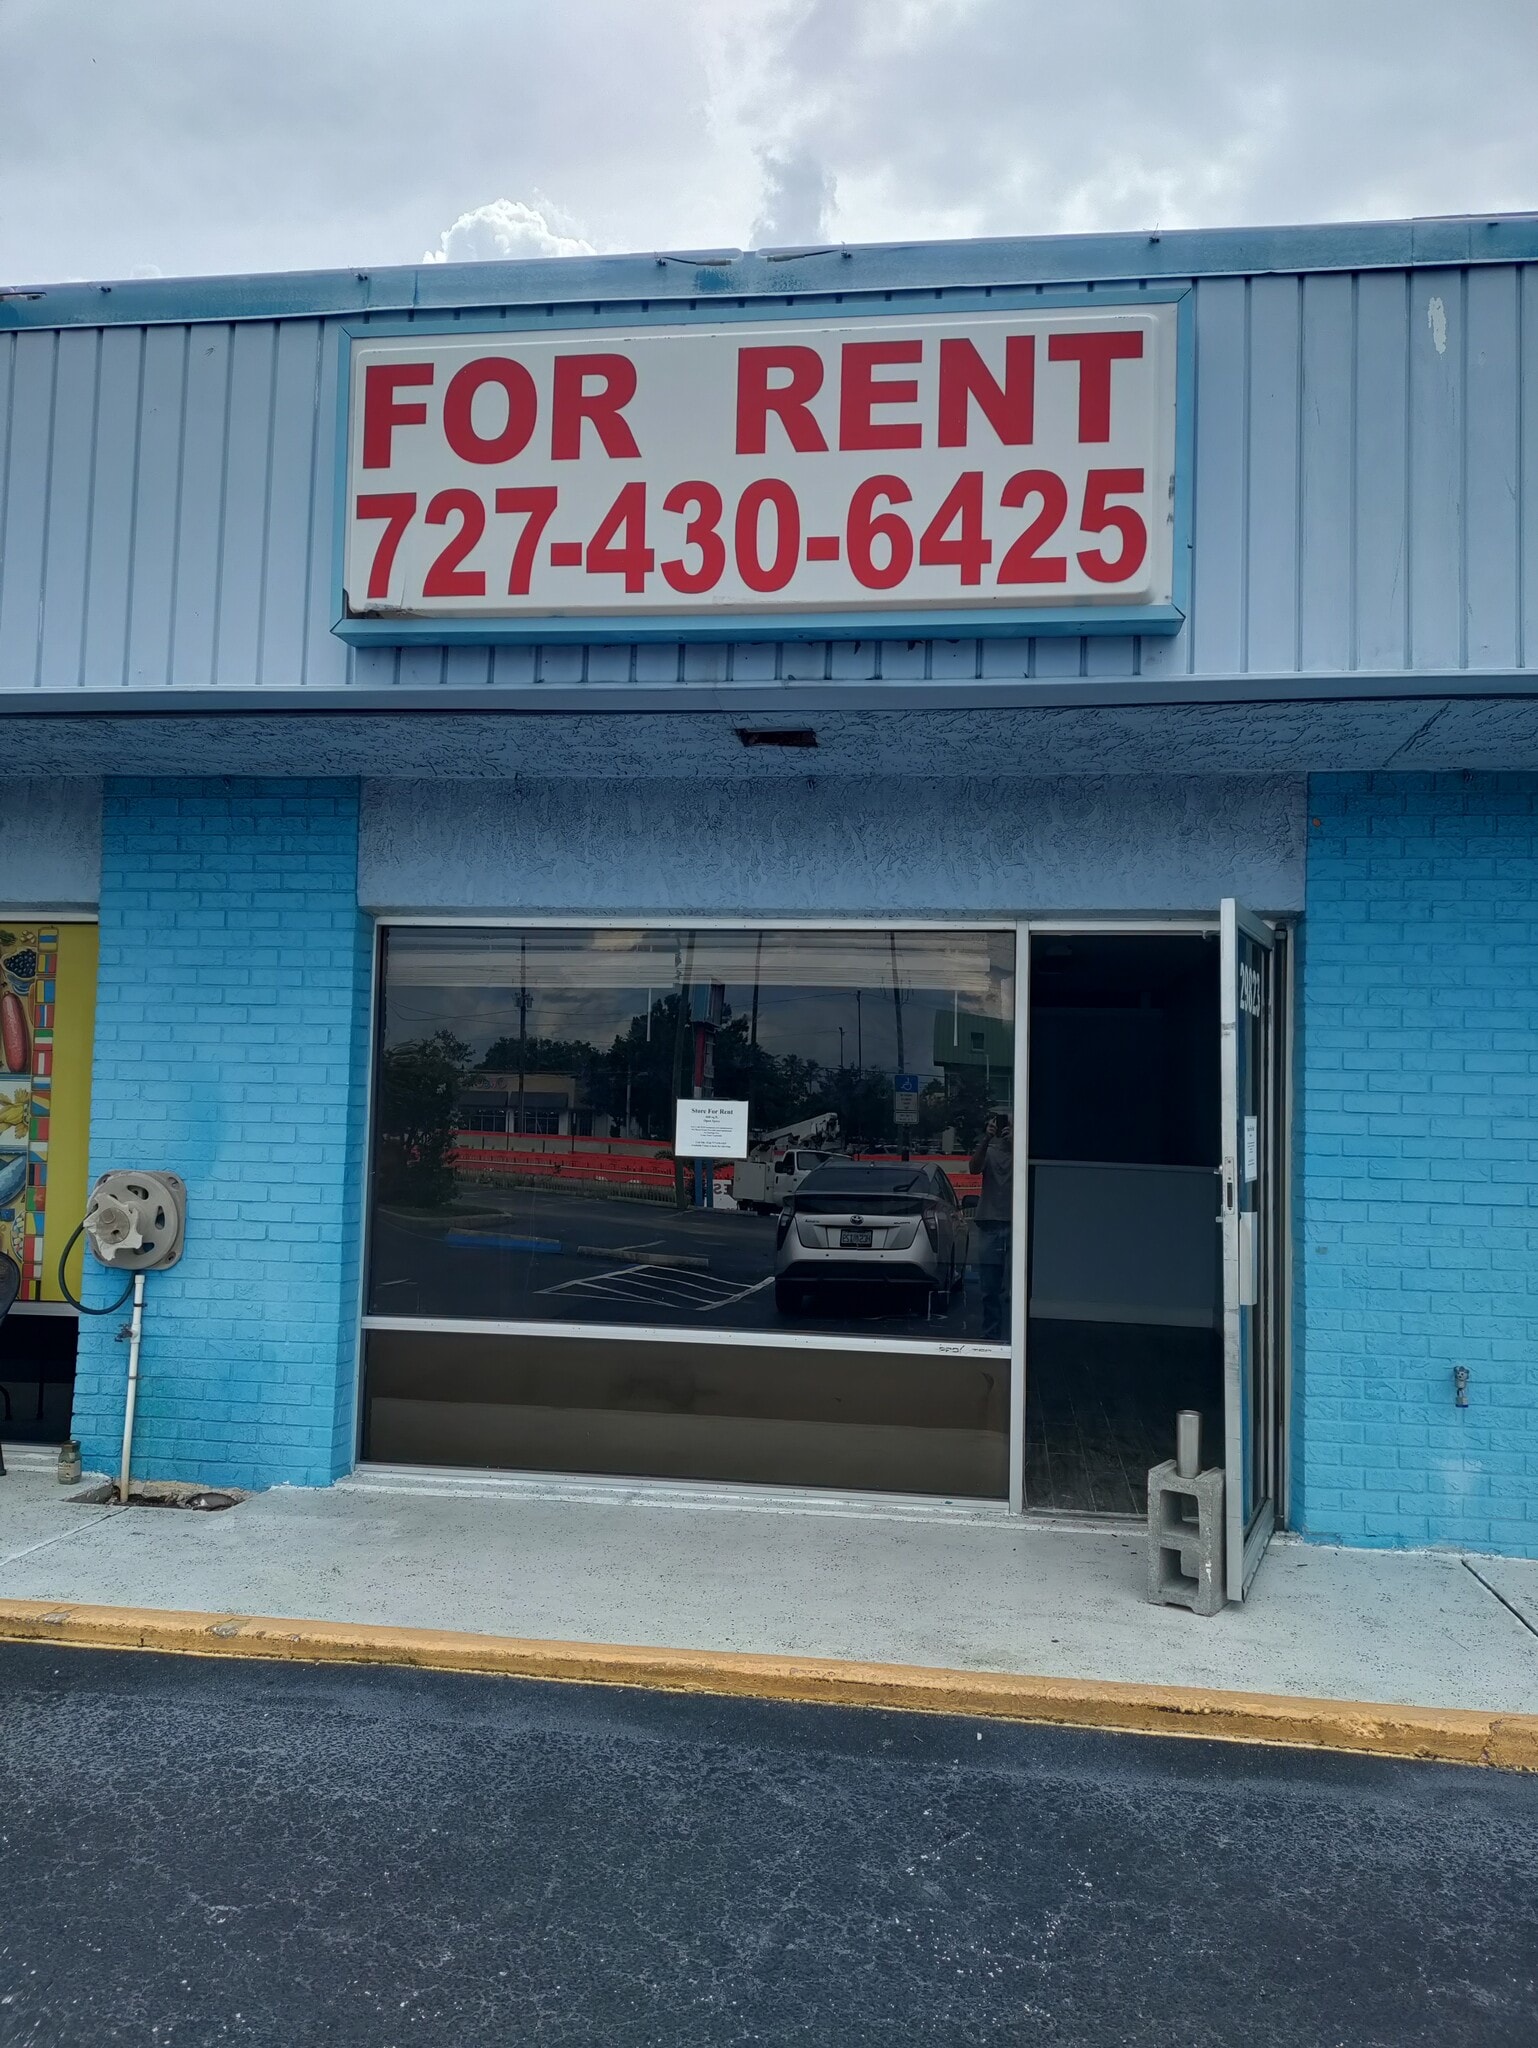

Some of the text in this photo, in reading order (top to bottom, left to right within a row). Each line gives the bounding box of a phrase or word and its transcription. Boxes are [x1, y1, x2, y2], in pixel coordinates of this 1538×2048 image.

[362, 330, 1144, 470] FOR RENT
[355, 466, 1148, 599] 727-430-6425
[1240, 961, 1260, 1018] 29823
